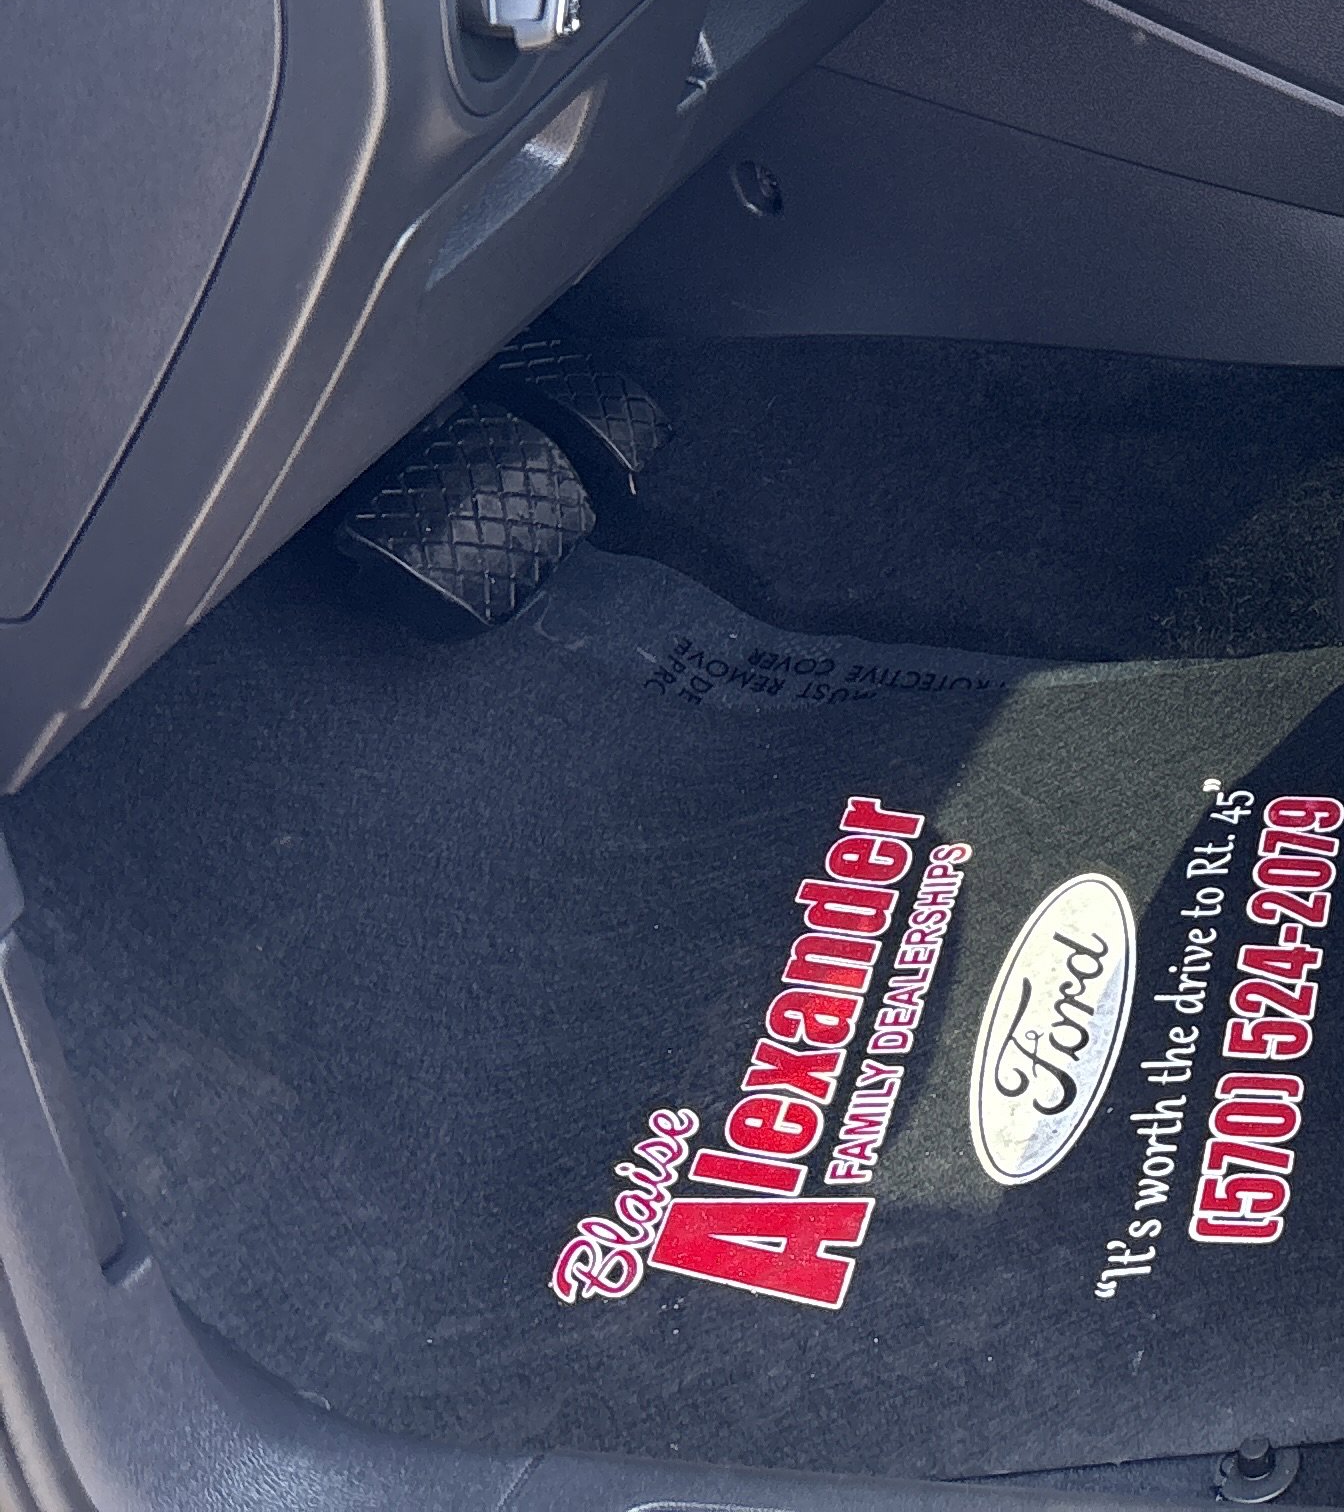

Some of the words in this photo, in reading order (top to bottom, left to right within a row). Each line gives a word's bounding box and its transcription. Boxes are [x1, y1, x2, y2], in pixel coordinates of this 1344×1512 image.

[748, 647, 836, 677] COVER
[846, 663, 1006, 693] ROTECTIVE
[1180, 887, 1225, 918] to
[1186, 834, 1236, 879] Rt.
[1153, 928, 1217, 1014] drive
[1222, 795, 1344, 1061] 524-2079
[647, 796, 926, 1310] Alexander
[824, 1059, 904, 1185] FAMILY
[866, 842, 973, 1054] DEALERSHIPS
[994, 930, 1108, 1115] Ford
[1140, 1025, 1199, 1085] the
[552, 1108, 699, 1304] Blaise
[1129, 1094, 1187, 1210] worth
[1188, 1071, 1305, 1245] (570)
